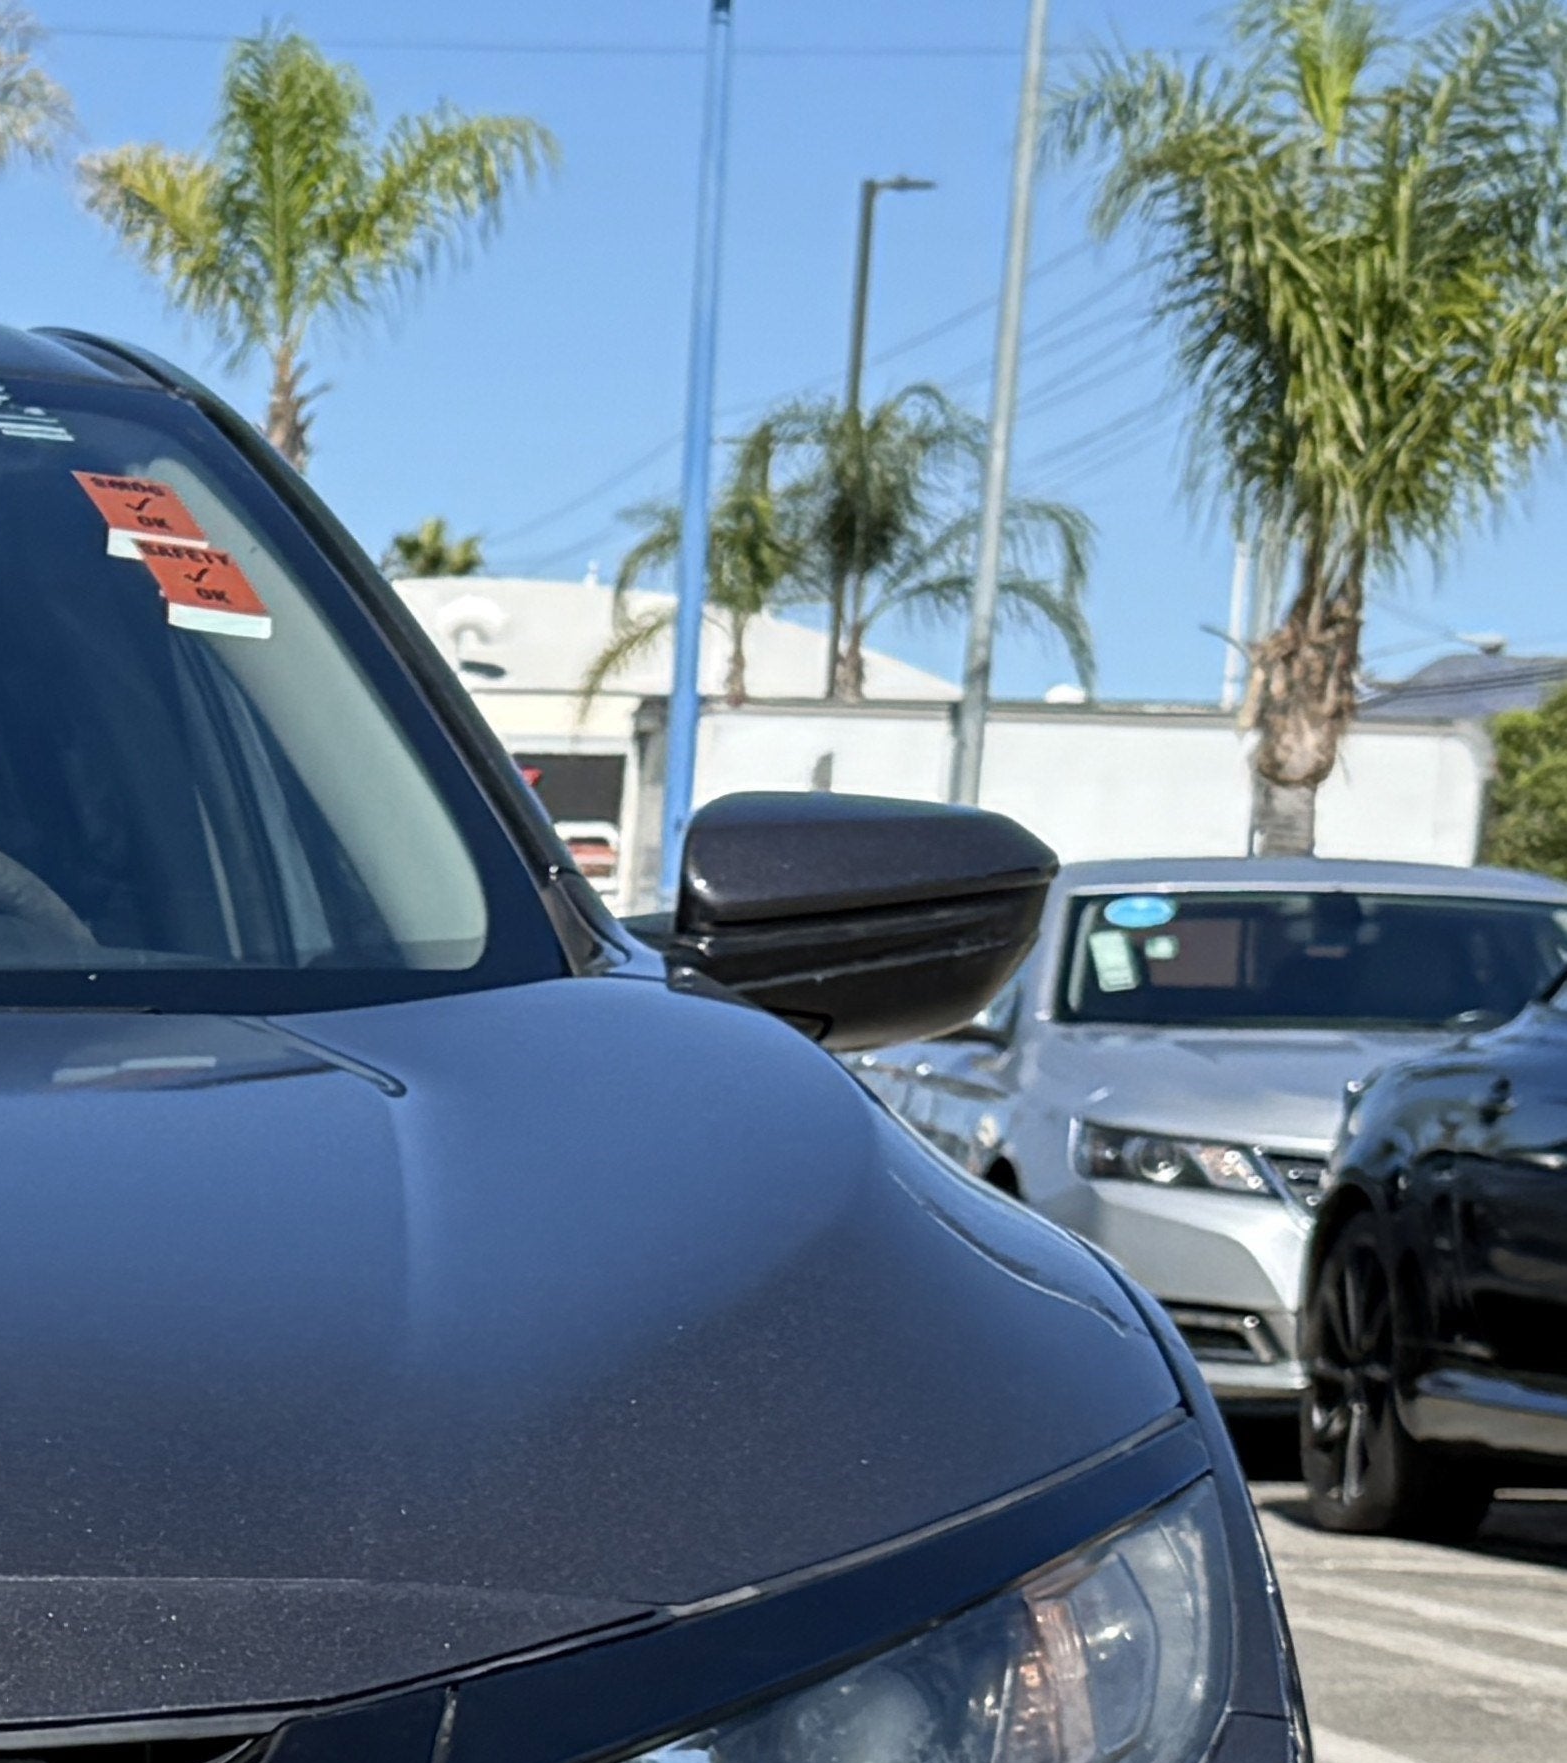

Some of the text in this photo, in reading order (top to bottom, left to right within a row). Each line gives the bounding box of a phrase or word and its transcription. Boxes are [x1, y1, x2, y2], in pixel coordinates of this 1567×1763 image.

[136, 515, 172, 531] OK
[136, 541, 230, 567] SAFETY
[196, 587, 232, 604] OK
